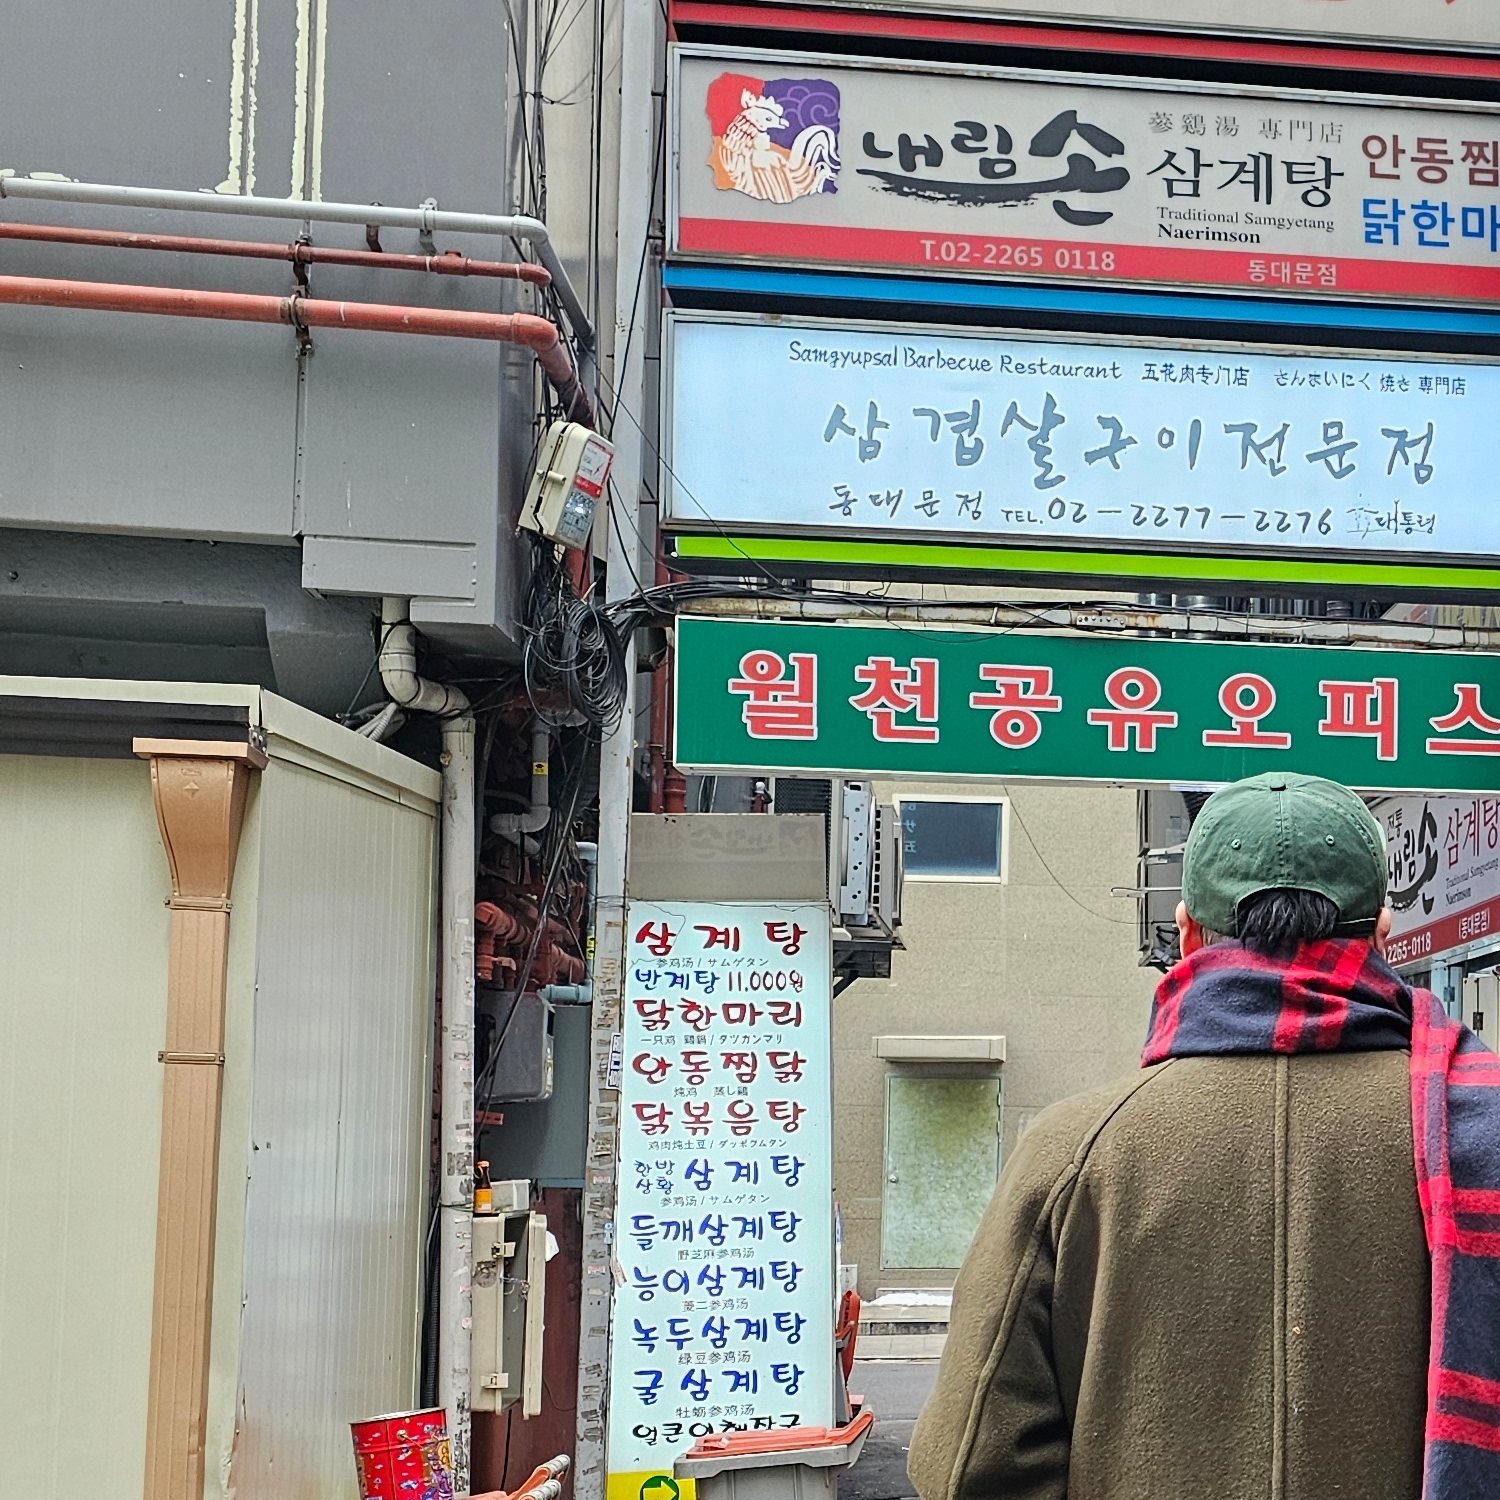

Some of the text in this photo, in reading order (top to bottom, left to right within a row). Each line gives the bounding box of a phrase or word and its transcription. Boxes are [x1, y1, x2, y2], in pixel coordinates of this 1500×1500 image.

[856, 110, 1131, 227] 내림손
[1147, 147, 1345, 208] 삼계탕
[1157, 206, 1335, 233] Traditional Samgyetang
[1157, 223, 1261, 245] Naerimson
[1054, 245, 1115, 272] 0118
[1247, 259, 1338, 287] 동대문점
[789, 340, 1122, 379] Samgyupsal Barbecue Restaurant
[635, 921, 809, 956] 삼계탕
[635, 968, 720, 994] 반계탕
[633, 998, 803, 1032] 닭한마리
[633, 1050, 807, 1086] 안동찜닭
[632, 1099, 807, 1137] 닭볶음탕
[684, 1155, 806, 1192] 삼계탕
[630, 1210, 803, 1252] 들깨삼계탕
[632, 1312, 807, 1354] 녹두삼계탕
[632, 1363, 805, 1406] 굴삼계탕
